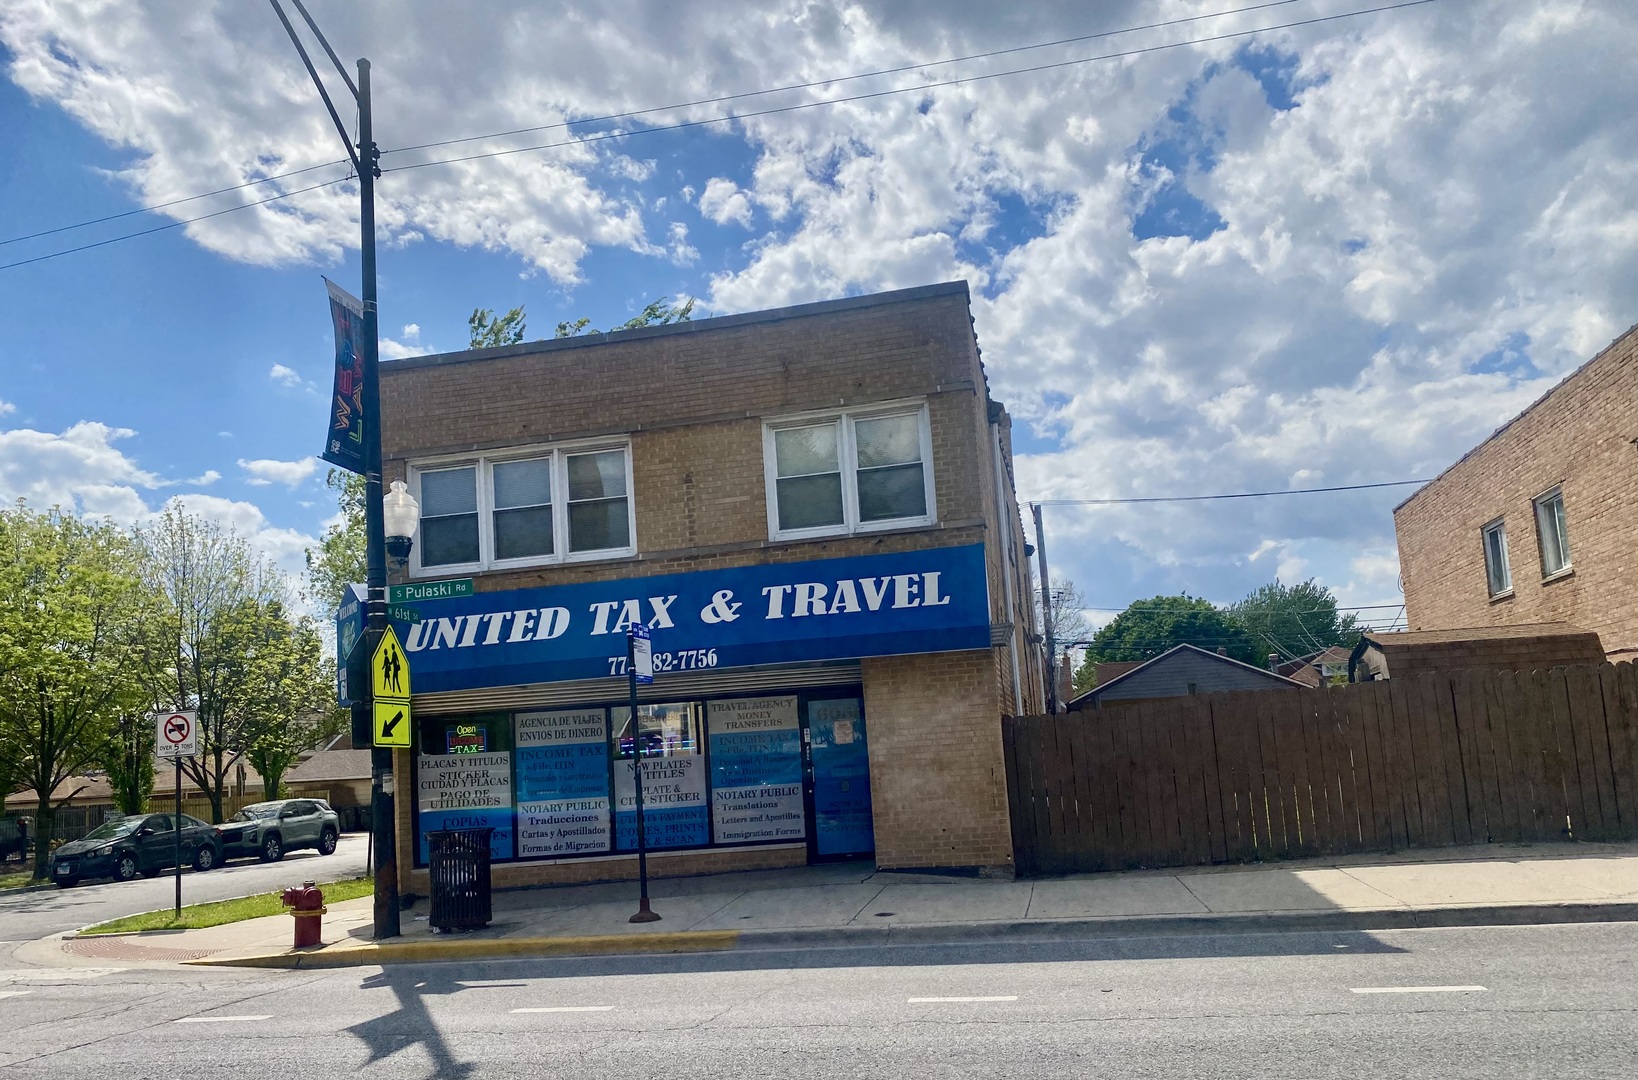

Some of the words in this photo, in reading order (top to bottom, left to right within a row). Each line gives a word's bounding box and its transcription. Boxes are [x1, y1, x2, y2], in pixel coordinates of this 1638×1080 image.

[405, 583, 452, 599] Pulaski
[394, 608, 410, 620] 61st
[406, 606, 571, 652] UNITED
[588, 594, 678, 636] TAX
[700, 589, 743, 624] &
[761, 571, 950, 620] TRAVEL
[712, 702, 750, 712] TRAVEL
[752, 698, 793, 710] AGENCY
[520, 717, 558, 728] AGENCIA
[559, 716, 572, 726] DE
[572, 714, 602, 725] VIAJES
[737, 711, 772, 720] MONEY
[456, 725, 476, 735] Open
[725, 719, 782, 730] TRANSFERS
[520, 730, 553, 742] ENVIOS
[554, 729, 567, 740] DE
[568, 727, 603, 738] DINERO
[720, 734, 766, 746] INCOME
[768, 733, 790, 742] TAX
[450, 736, 484, 746] INCOME
[455, 744, 478, 754] TAX
[520, 748, 574, 760] INCOME
[578, 746, 604, 756] TAX
[421, 758, 458, 770] PLACAS
[459, 758, 466, 768] Y
[468, 756, 509, 767] TITULOS
[554, 760, 575, 770] ITIN
[628, 762, 650, 772] NW
[653, 760, 692, 770] PLATES
[439, 770, 490, 781] STICKER
[644, 769, 686, 780] TITLES
[421, 780, 460, 790] CIUDAD
[460, 779, 468, 788] Y
[470, 776, 509, 788] PLACAS
[674, 784, 682, 794] &
[440, 790, 472, 800] PAGO
[474, 789, 490, 798] DE
[650, 792, 700, 804] STICKER
[716, 790, 758, 800] NOTARY
[760, 786, 799, 798] PUBLIC
[430, 796, 501, 810] UTILIDADES
[522, 803, 564, 814] NOTARY
[566, 801, 606, 812] PUBLIC
[722, 802, 778, 811] Translations
[443, 816, 488, 828] COPIAS
[528, 814, 600, 826] Traducciones
[722, 816, 748, 825] Letters
[764, 812, 801, 823] Apostilles
[522, 830, 548, 838] Cartas
[550, 830, 556, 839] y
[557, 826, 606, 838] Apostillados
[665, 822, 705, 834] PRINTS
[722, 829, 774, 840] Immigration
[775, 828, 802, 836] Forms
[522, 844, 552, 853] Formas
[554, 842, 564, 851] de
[566, 840, 606, 852] Migracion
[630, 838, 652, 848] FX
[654, 837, 662, 846] &
[666, 834, 696, 846] SCAN
